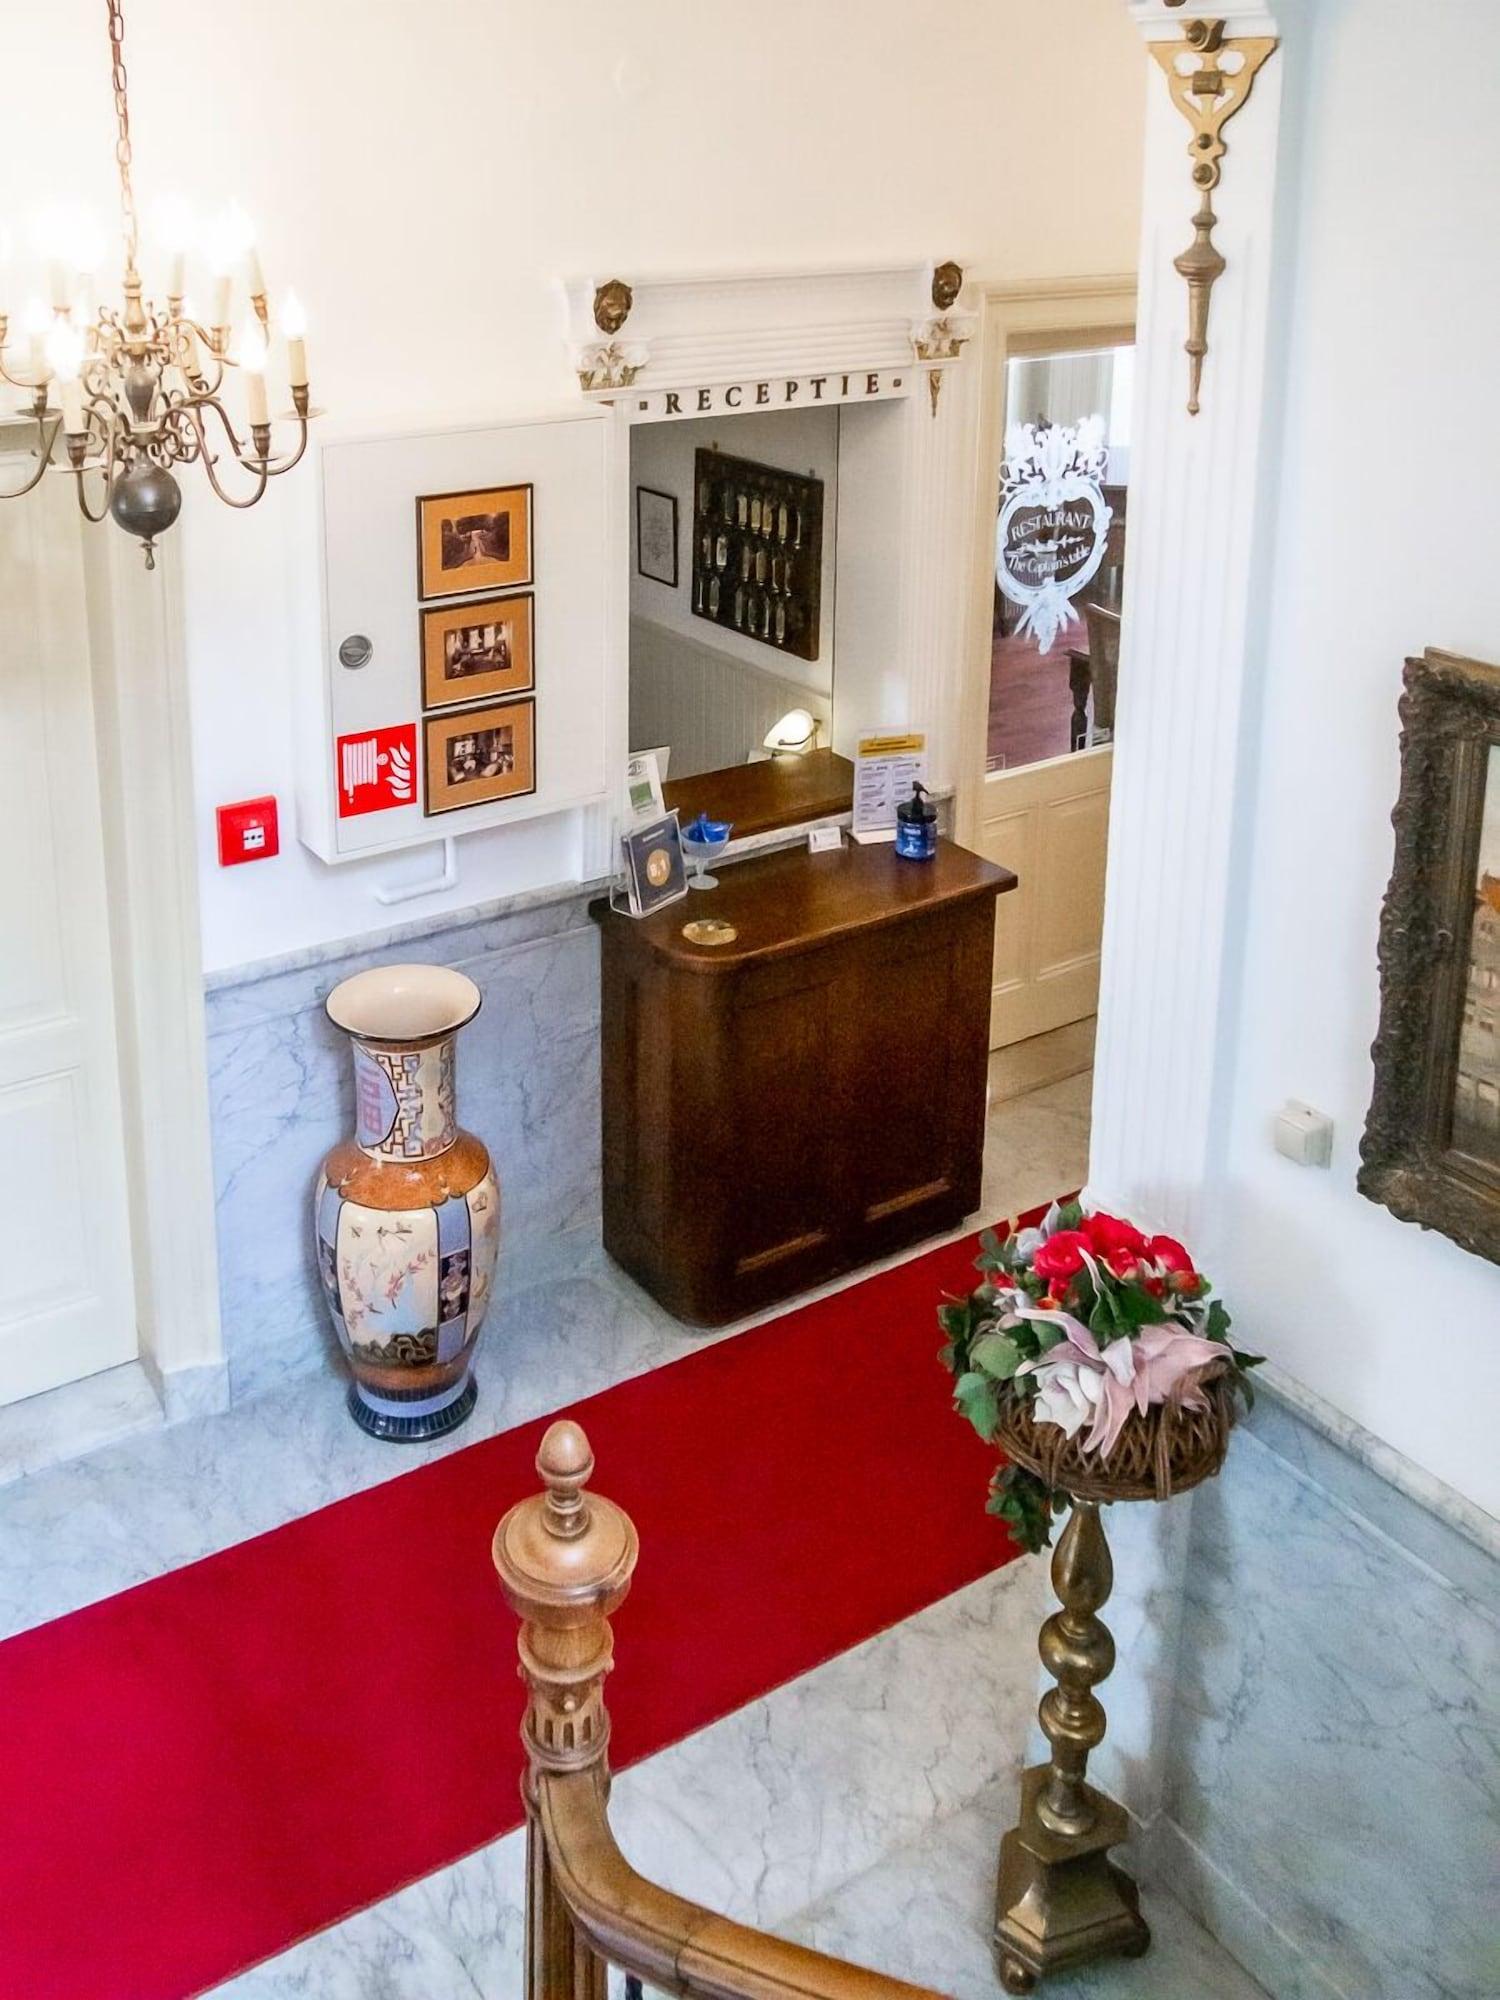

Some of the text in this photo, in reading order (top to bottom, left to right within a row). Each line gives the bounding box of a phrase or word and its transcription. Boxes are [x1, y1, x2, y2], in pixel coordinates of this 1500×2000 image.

[665, 373, 880, 415] RECEPTIE
[1011, 511, 1091, 541] RESTAURANT
[1008, 556, 1026, 572] The
